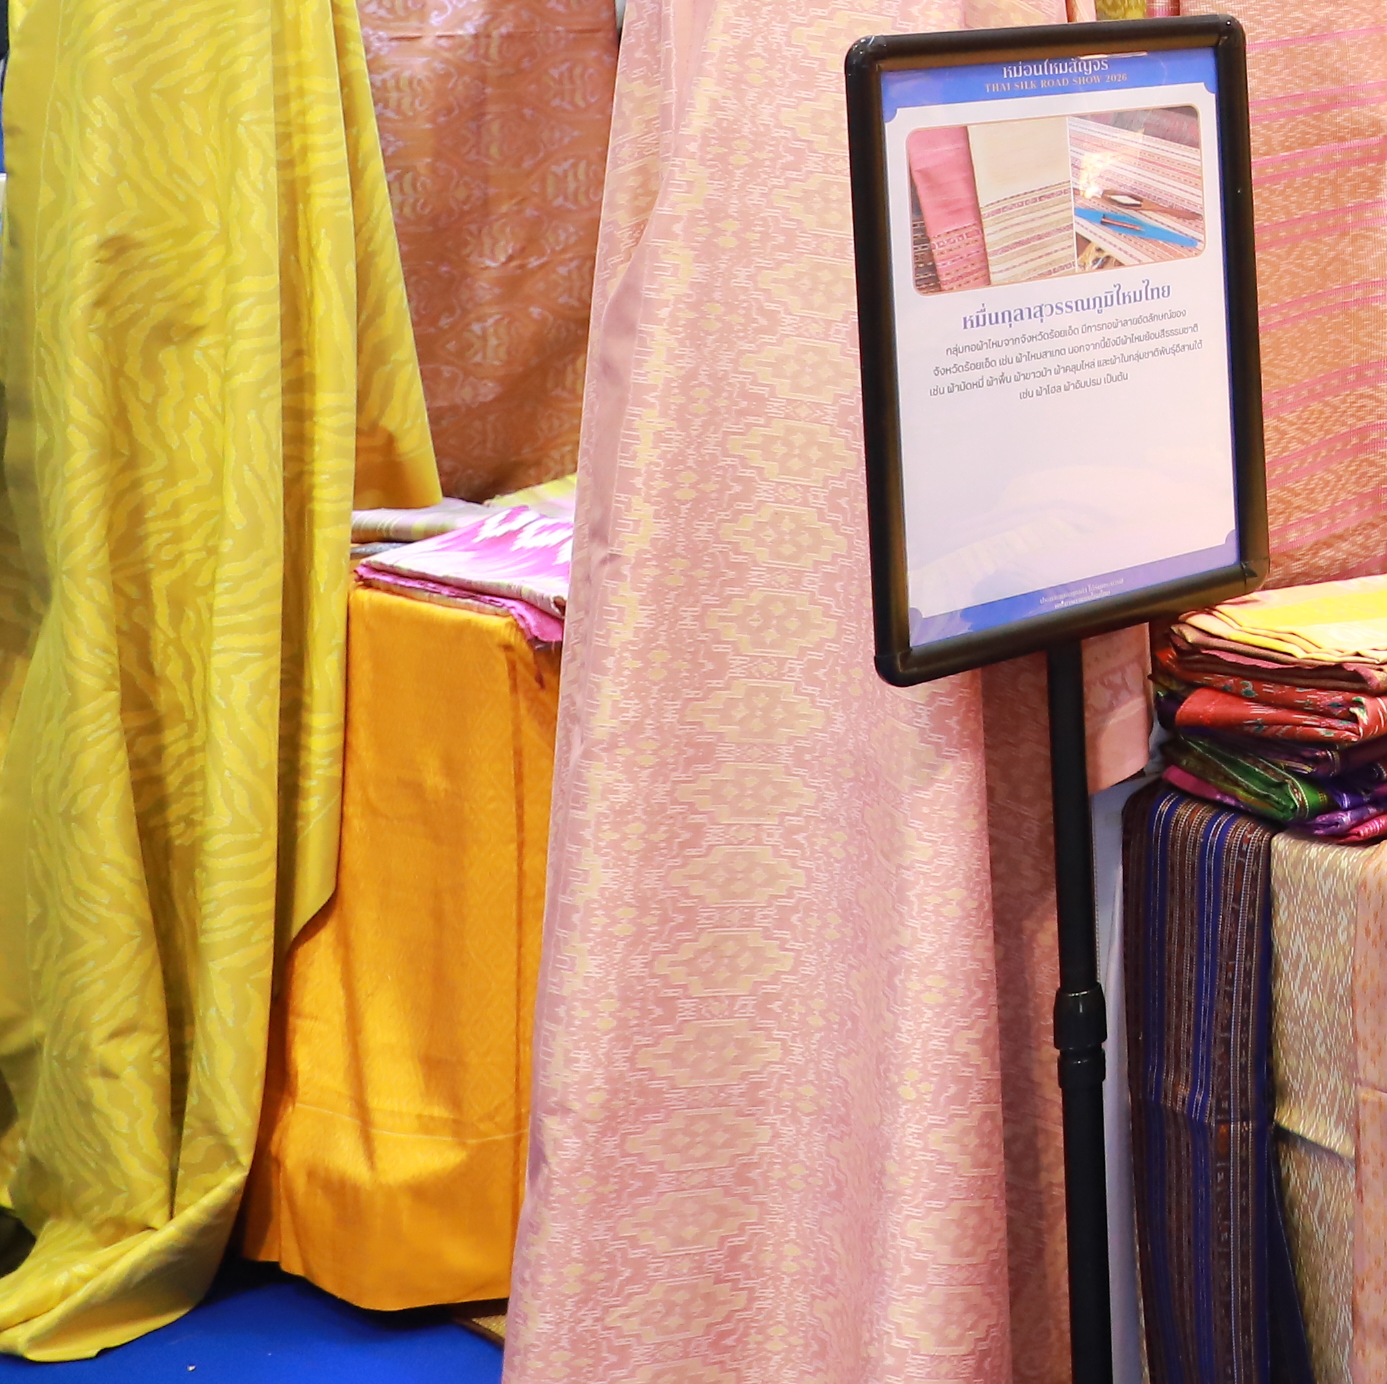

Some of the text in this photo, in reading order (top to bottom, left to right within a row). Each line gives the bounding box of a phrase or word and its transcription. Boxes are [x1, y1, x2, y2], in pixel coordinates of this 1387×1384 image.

[985, 73, 1128, 93] THAI SILK ROAD SHOW 2026
[962, 279, 1171, 329] หมื่นกุลาสุวรรณภูมิไหมไทย
